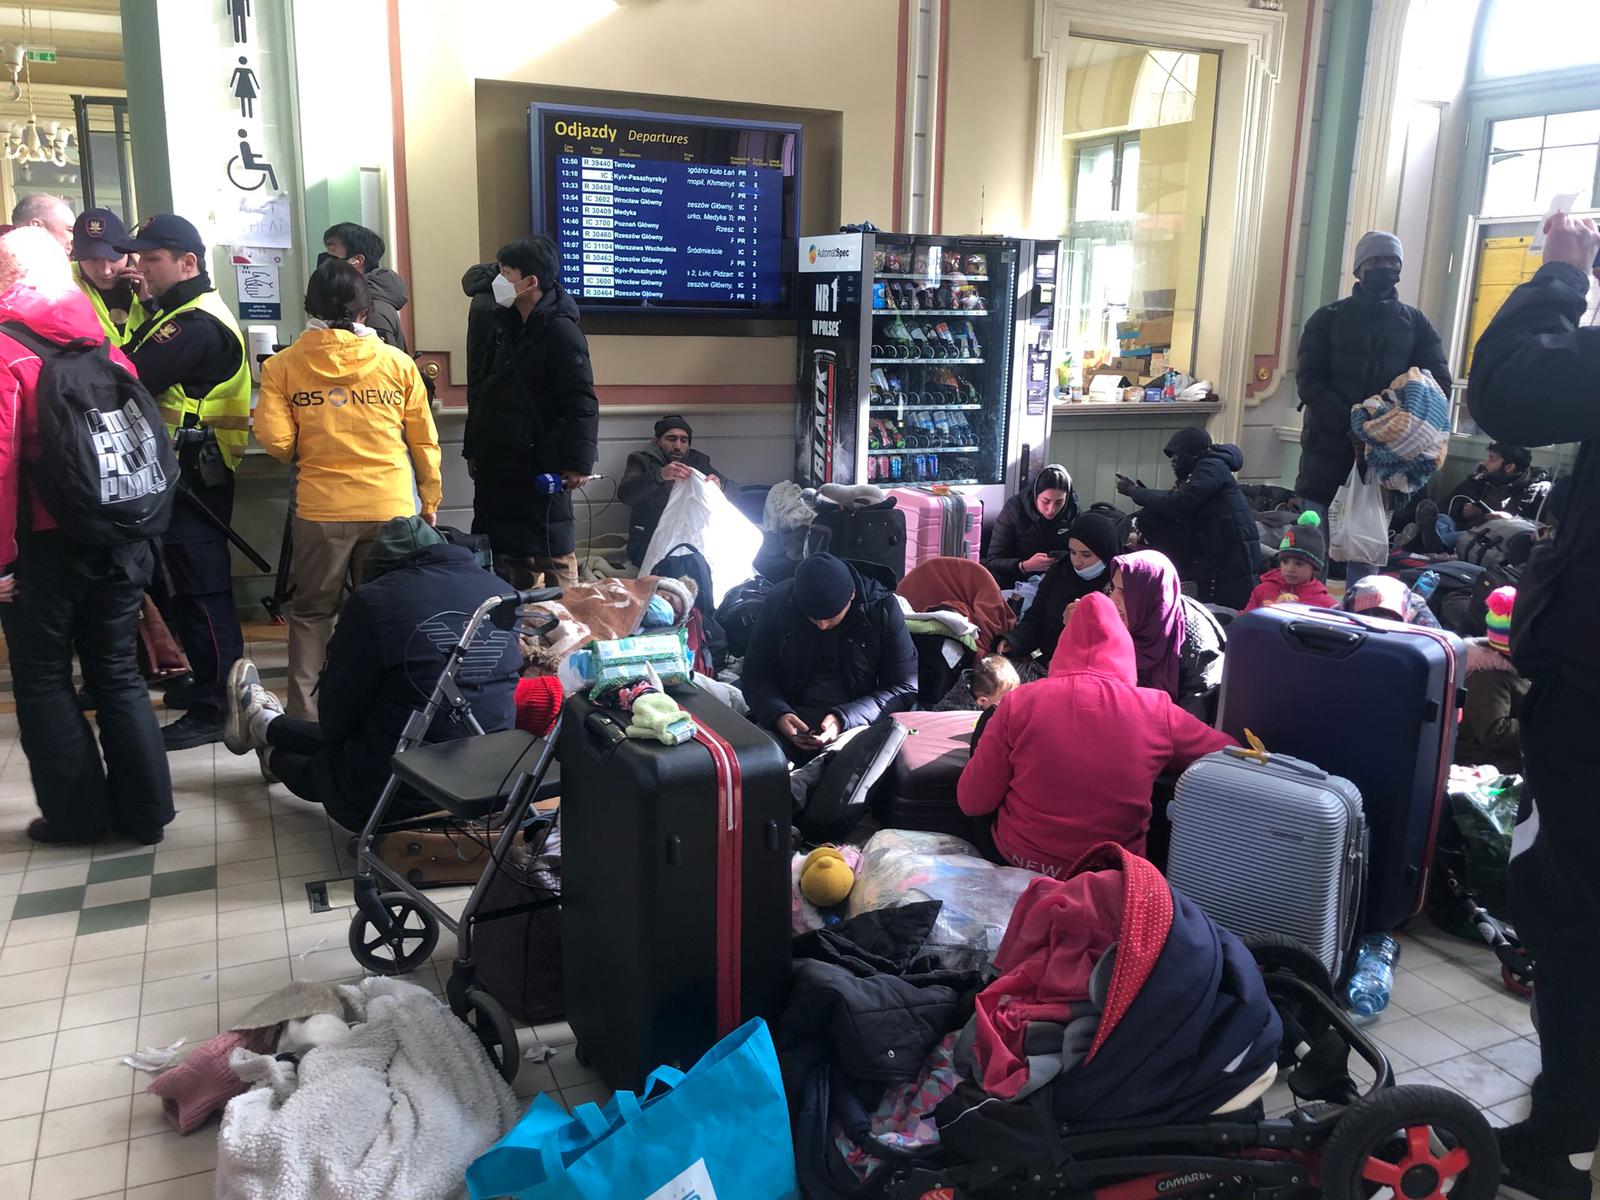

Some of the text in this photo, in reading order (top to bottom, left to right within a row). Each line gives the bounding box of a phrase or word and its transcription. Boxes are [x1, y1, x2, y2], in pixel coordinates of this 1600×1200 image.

[555, 121, 689, 144] Odjazdy Departures
[614, 161, 636, 169] Tarnów
[614, 185, 640, 193] Rzeszów
[641, 187, 663, 195] Główny
[614, 197, 639, 205] Wrocław
[640, 198, 662, 207] Główny
[592, 207, 611, 215] 30409
[614, 208, 637, 216] Medyka
[637, 221, 659, 230] Główny
[641, 233, 663, 242] Główny
[644, 245, 676, 253] Wschodnia
[817, 247, 849, 260] AutomatSpec
[641, 256, 663, 265] Główny
[615, 278, 640, 286] Wrocław
[640, 279, 662, 288] Główny
[641, 291, 663, 299] Główny
[815, 283, 830, 312] NR
[830, 278, 839, 313] 1
[812, 319, 819, 335] W
[291, 389, 403, 407] KBS NEWS
[814, 364, 828, 482] BLACK
